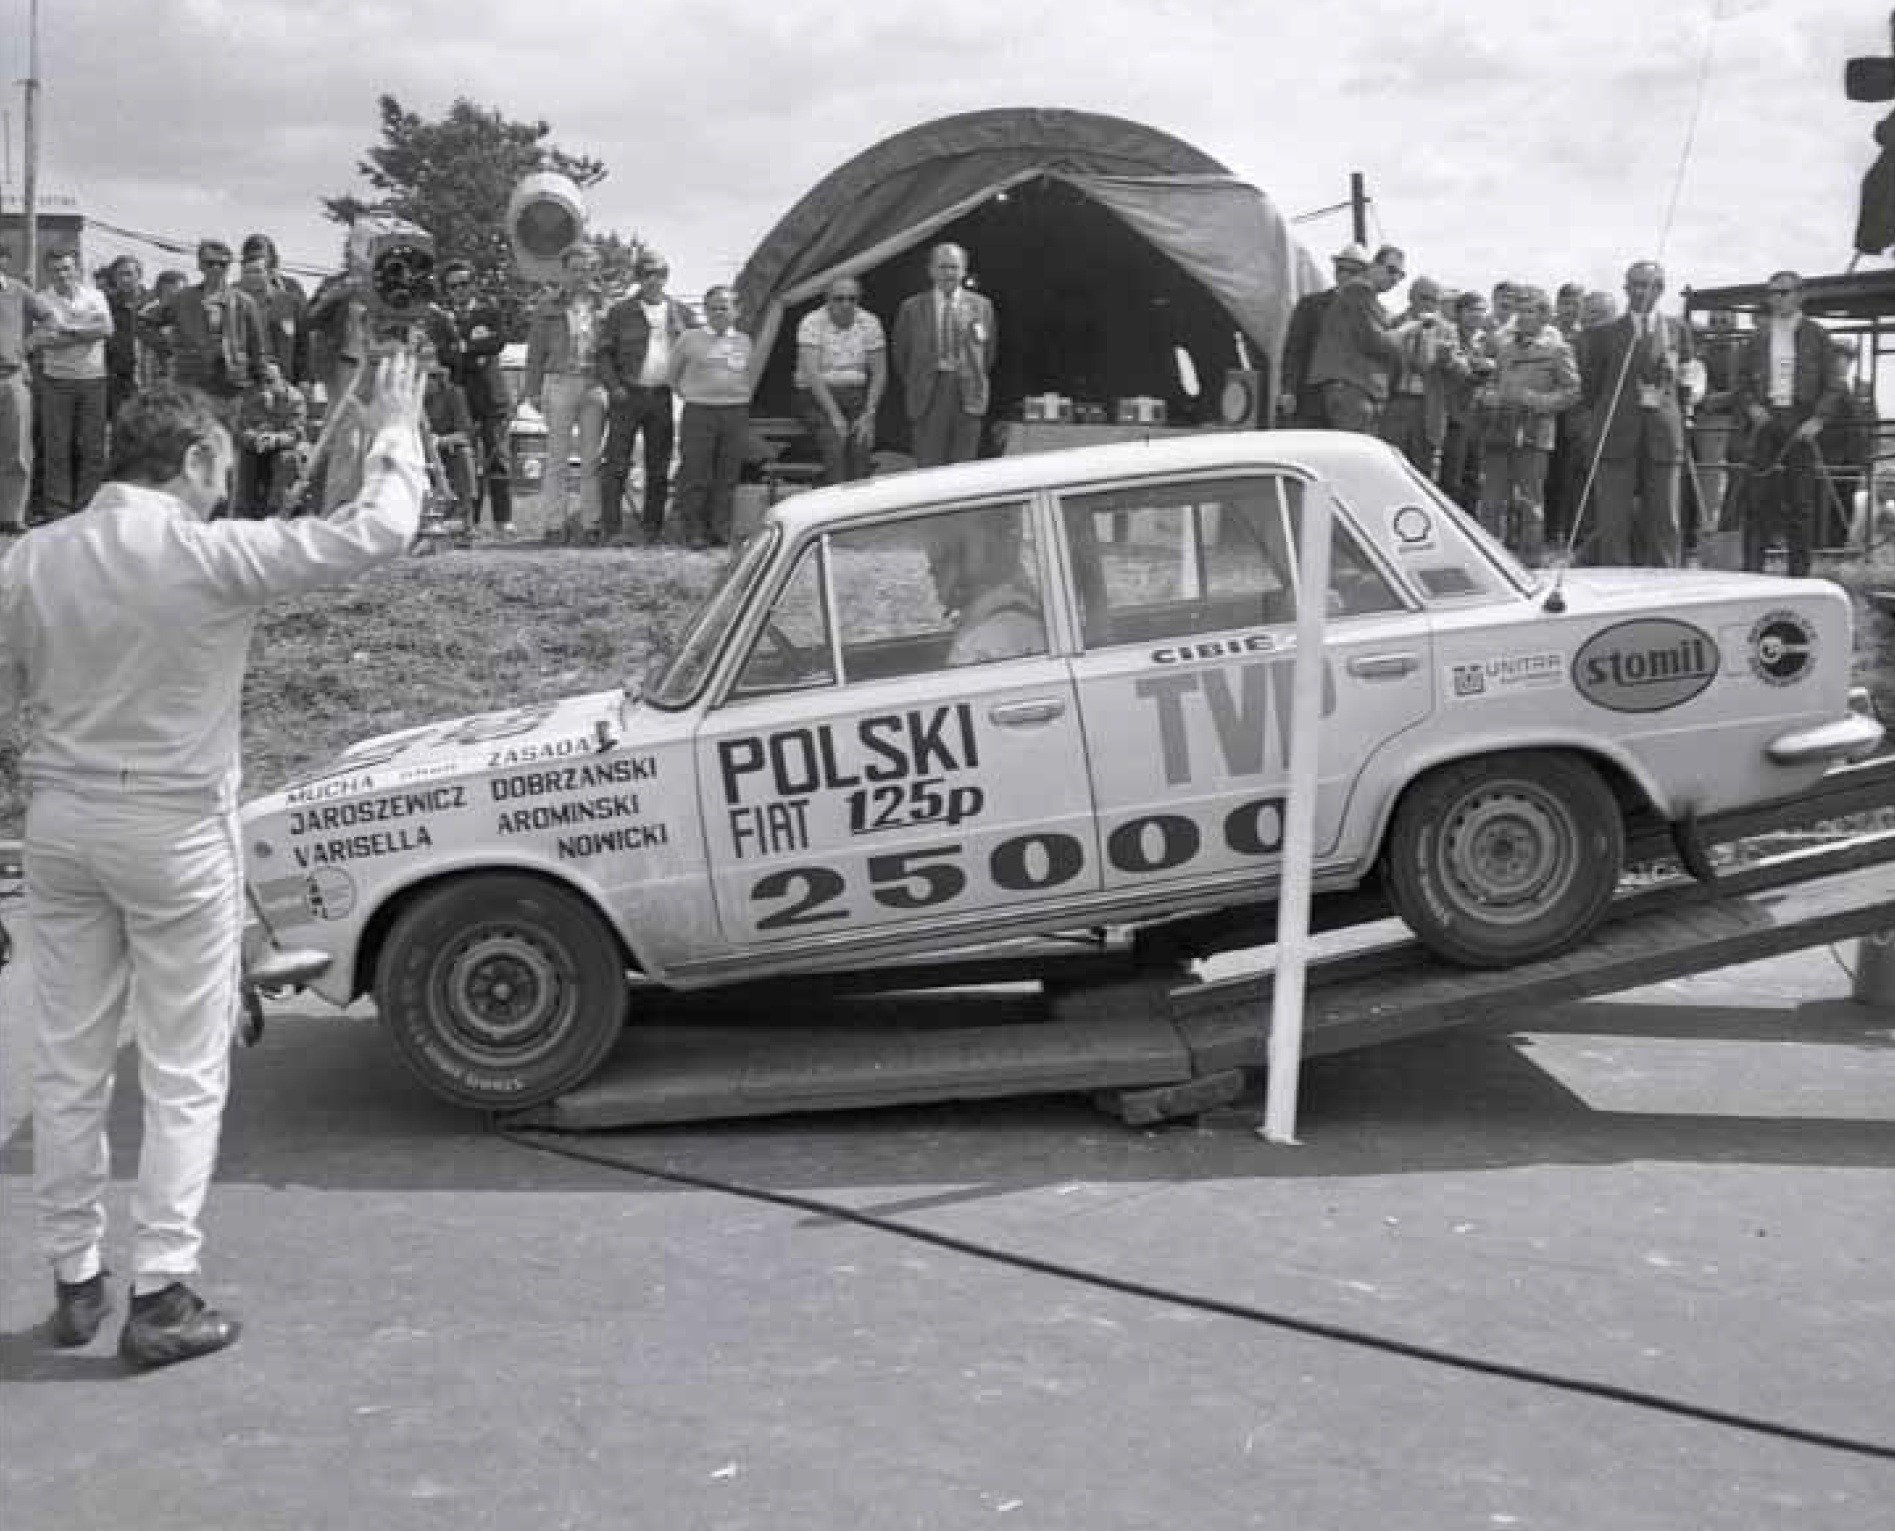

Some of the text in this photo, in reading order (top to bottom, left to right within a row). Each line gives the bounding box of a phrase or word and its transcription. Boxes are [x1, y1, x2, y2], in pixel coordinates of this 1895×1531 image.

[1588, 638, 1704, 687] stomil
[718, 702, 979, 804] POLSKI
[290, 786, 467, 835] JAROSZEWICZ
[729, 778, 984, 858] FIAT 125p
[292, 825, 433, 868] VARISELLA
[557, 823, 668, 859] NOWICKI
